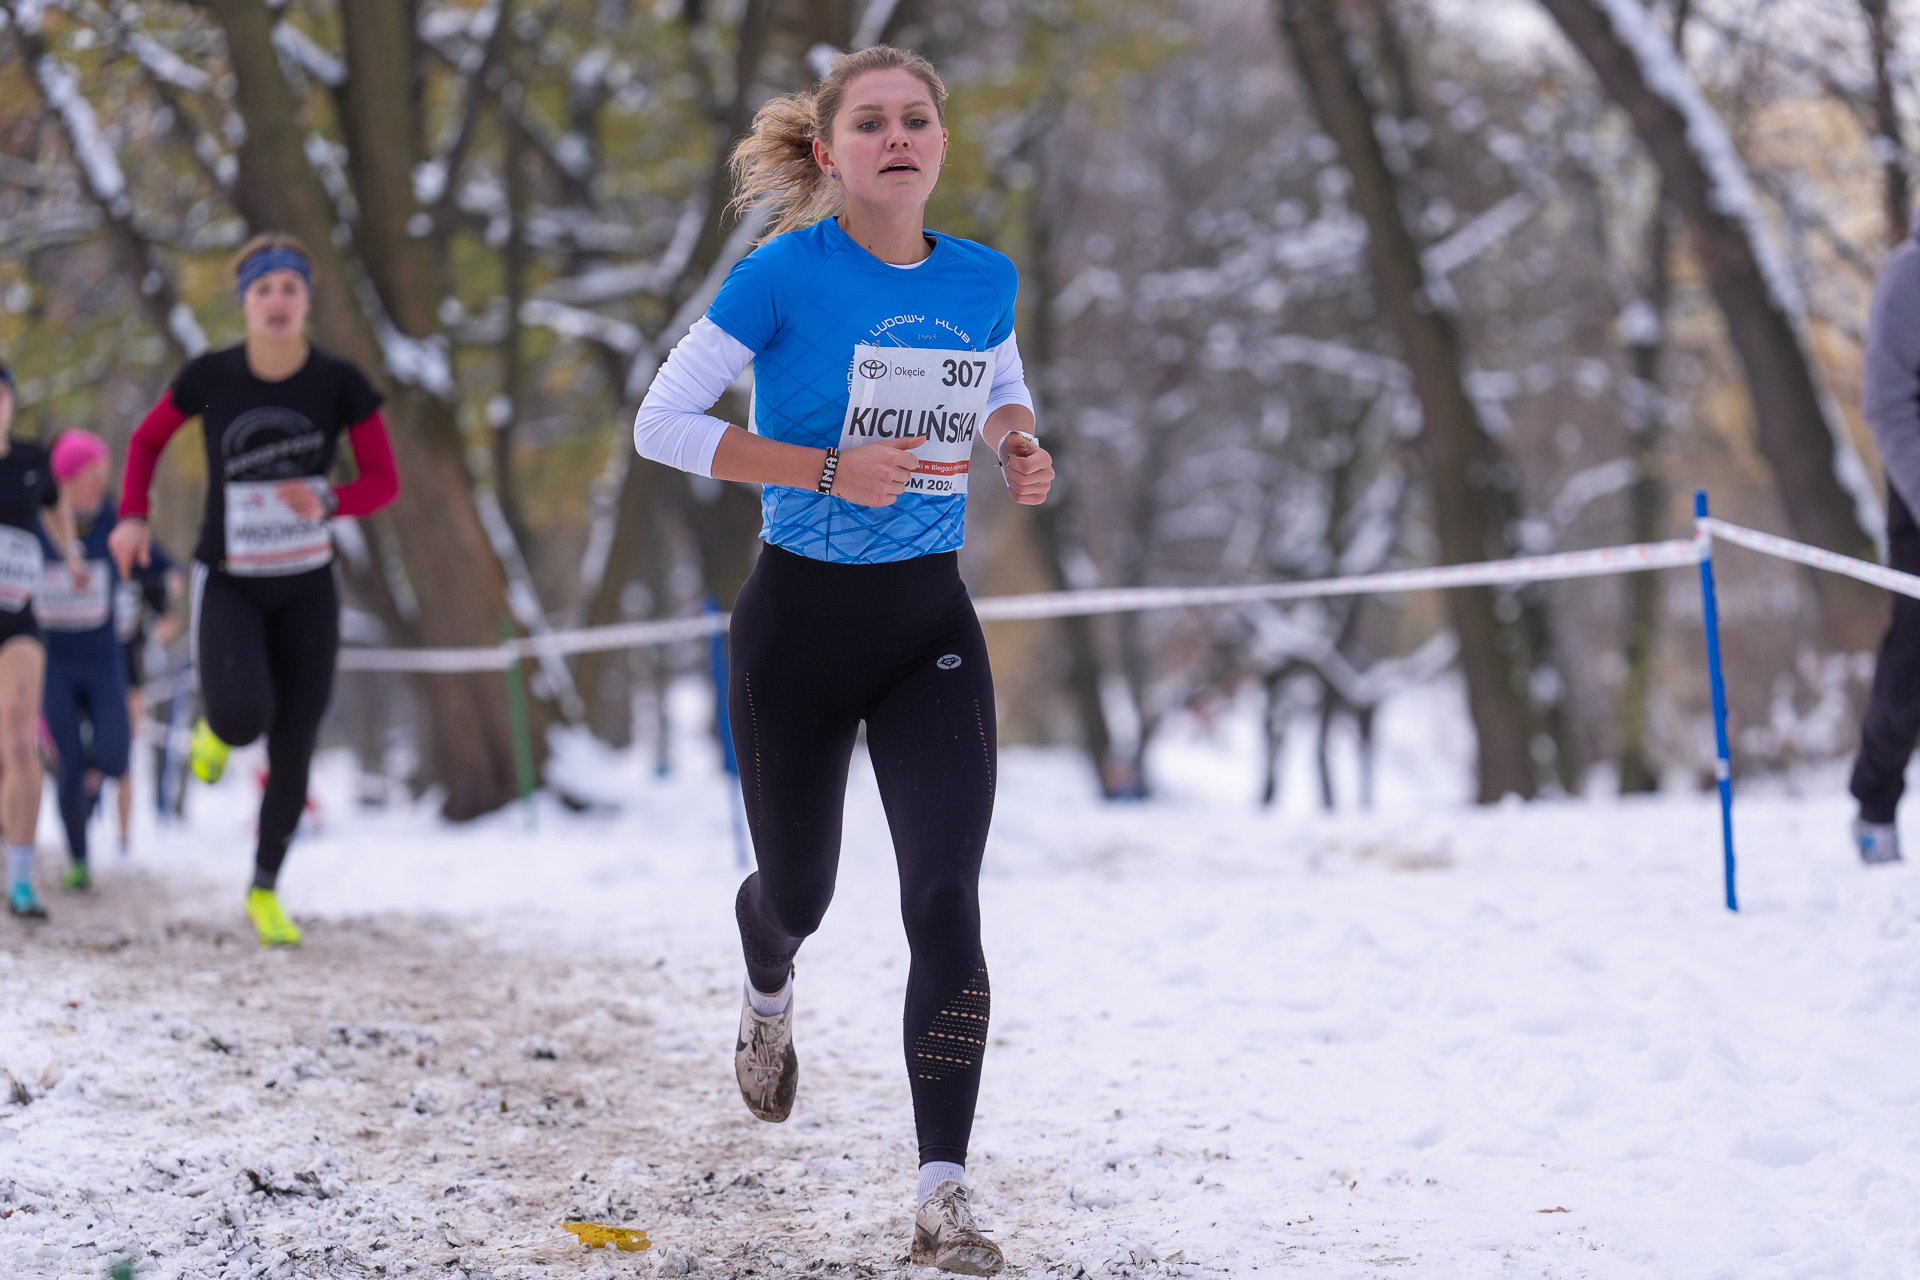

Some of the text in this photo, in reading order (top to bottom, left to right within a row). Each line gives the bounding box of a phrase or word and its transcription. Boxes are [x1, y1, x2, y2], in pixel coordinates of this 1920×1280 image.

[869, 315, 971, 343] LUDOWY KLUB
[894, 366, 926, 379] Okęcie
[941, 359, 987, 388] 307
[848, 404, 977, 444] KICILIŃSKA
